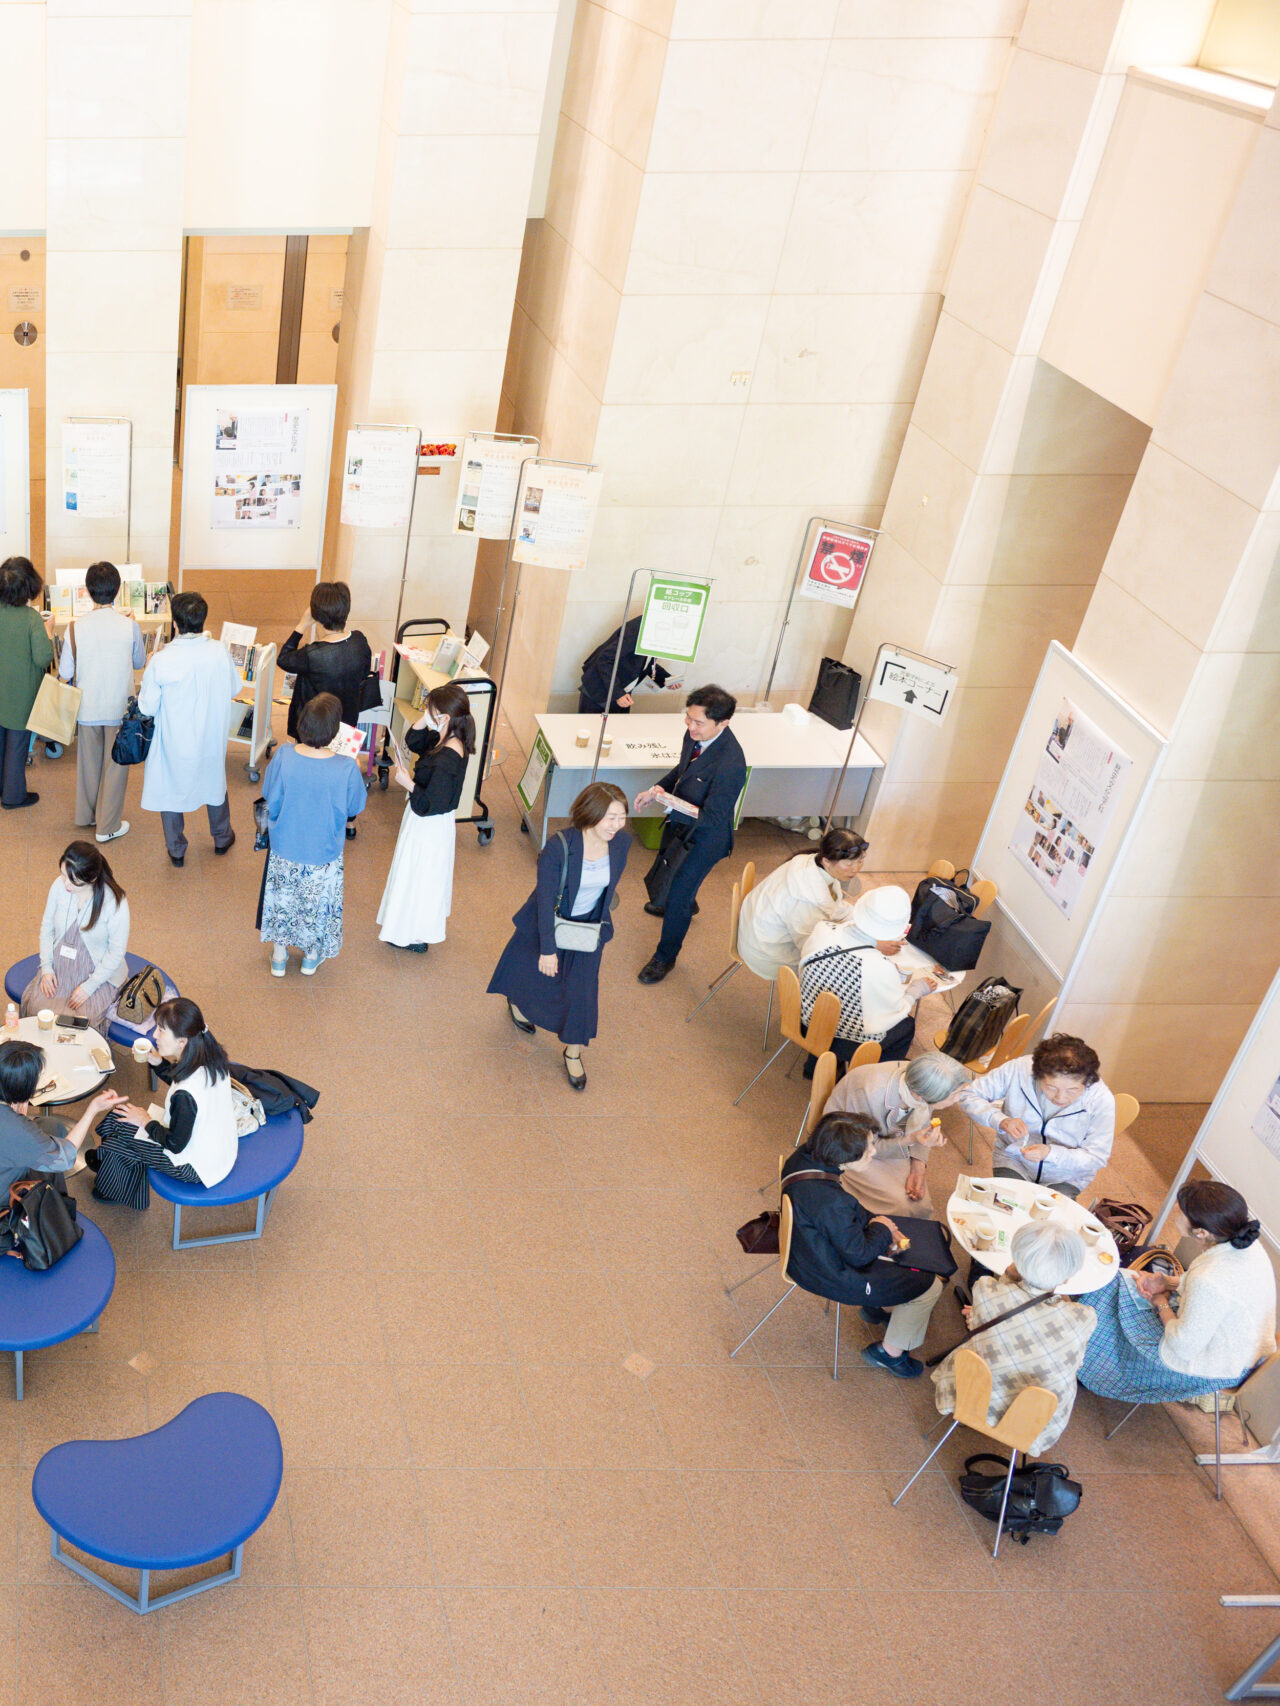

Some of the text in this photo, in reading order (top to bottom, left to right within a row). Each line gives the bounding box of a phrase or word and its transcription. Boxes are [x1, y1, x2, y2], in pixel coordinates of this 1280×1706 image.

[888, 672, 942, 697] 絵本コーナー
